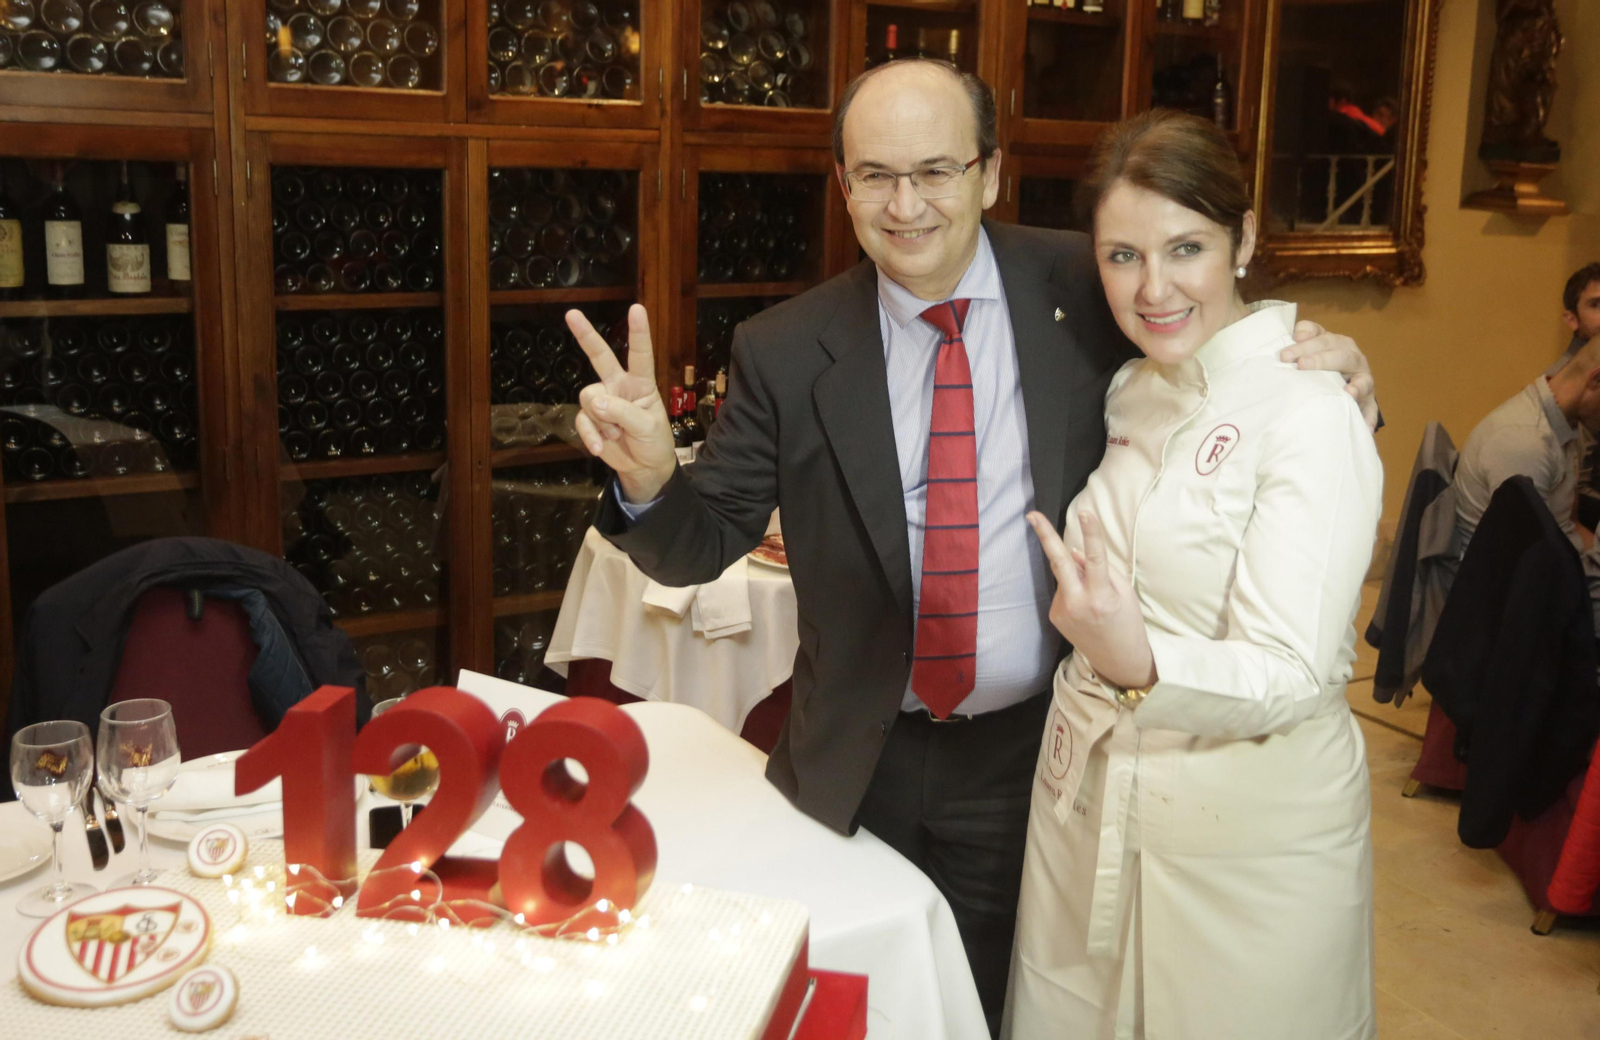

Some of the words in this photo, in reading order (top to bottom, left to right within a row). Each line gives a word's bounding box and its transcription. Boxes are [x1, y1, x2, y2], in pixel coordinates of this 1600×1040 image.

[1206, 443, 1224, 463] R
[1053, 734, 1063, 765] R
[235, 685, 657, 938] 128
[492, 800, 516, 813] CATERIN
